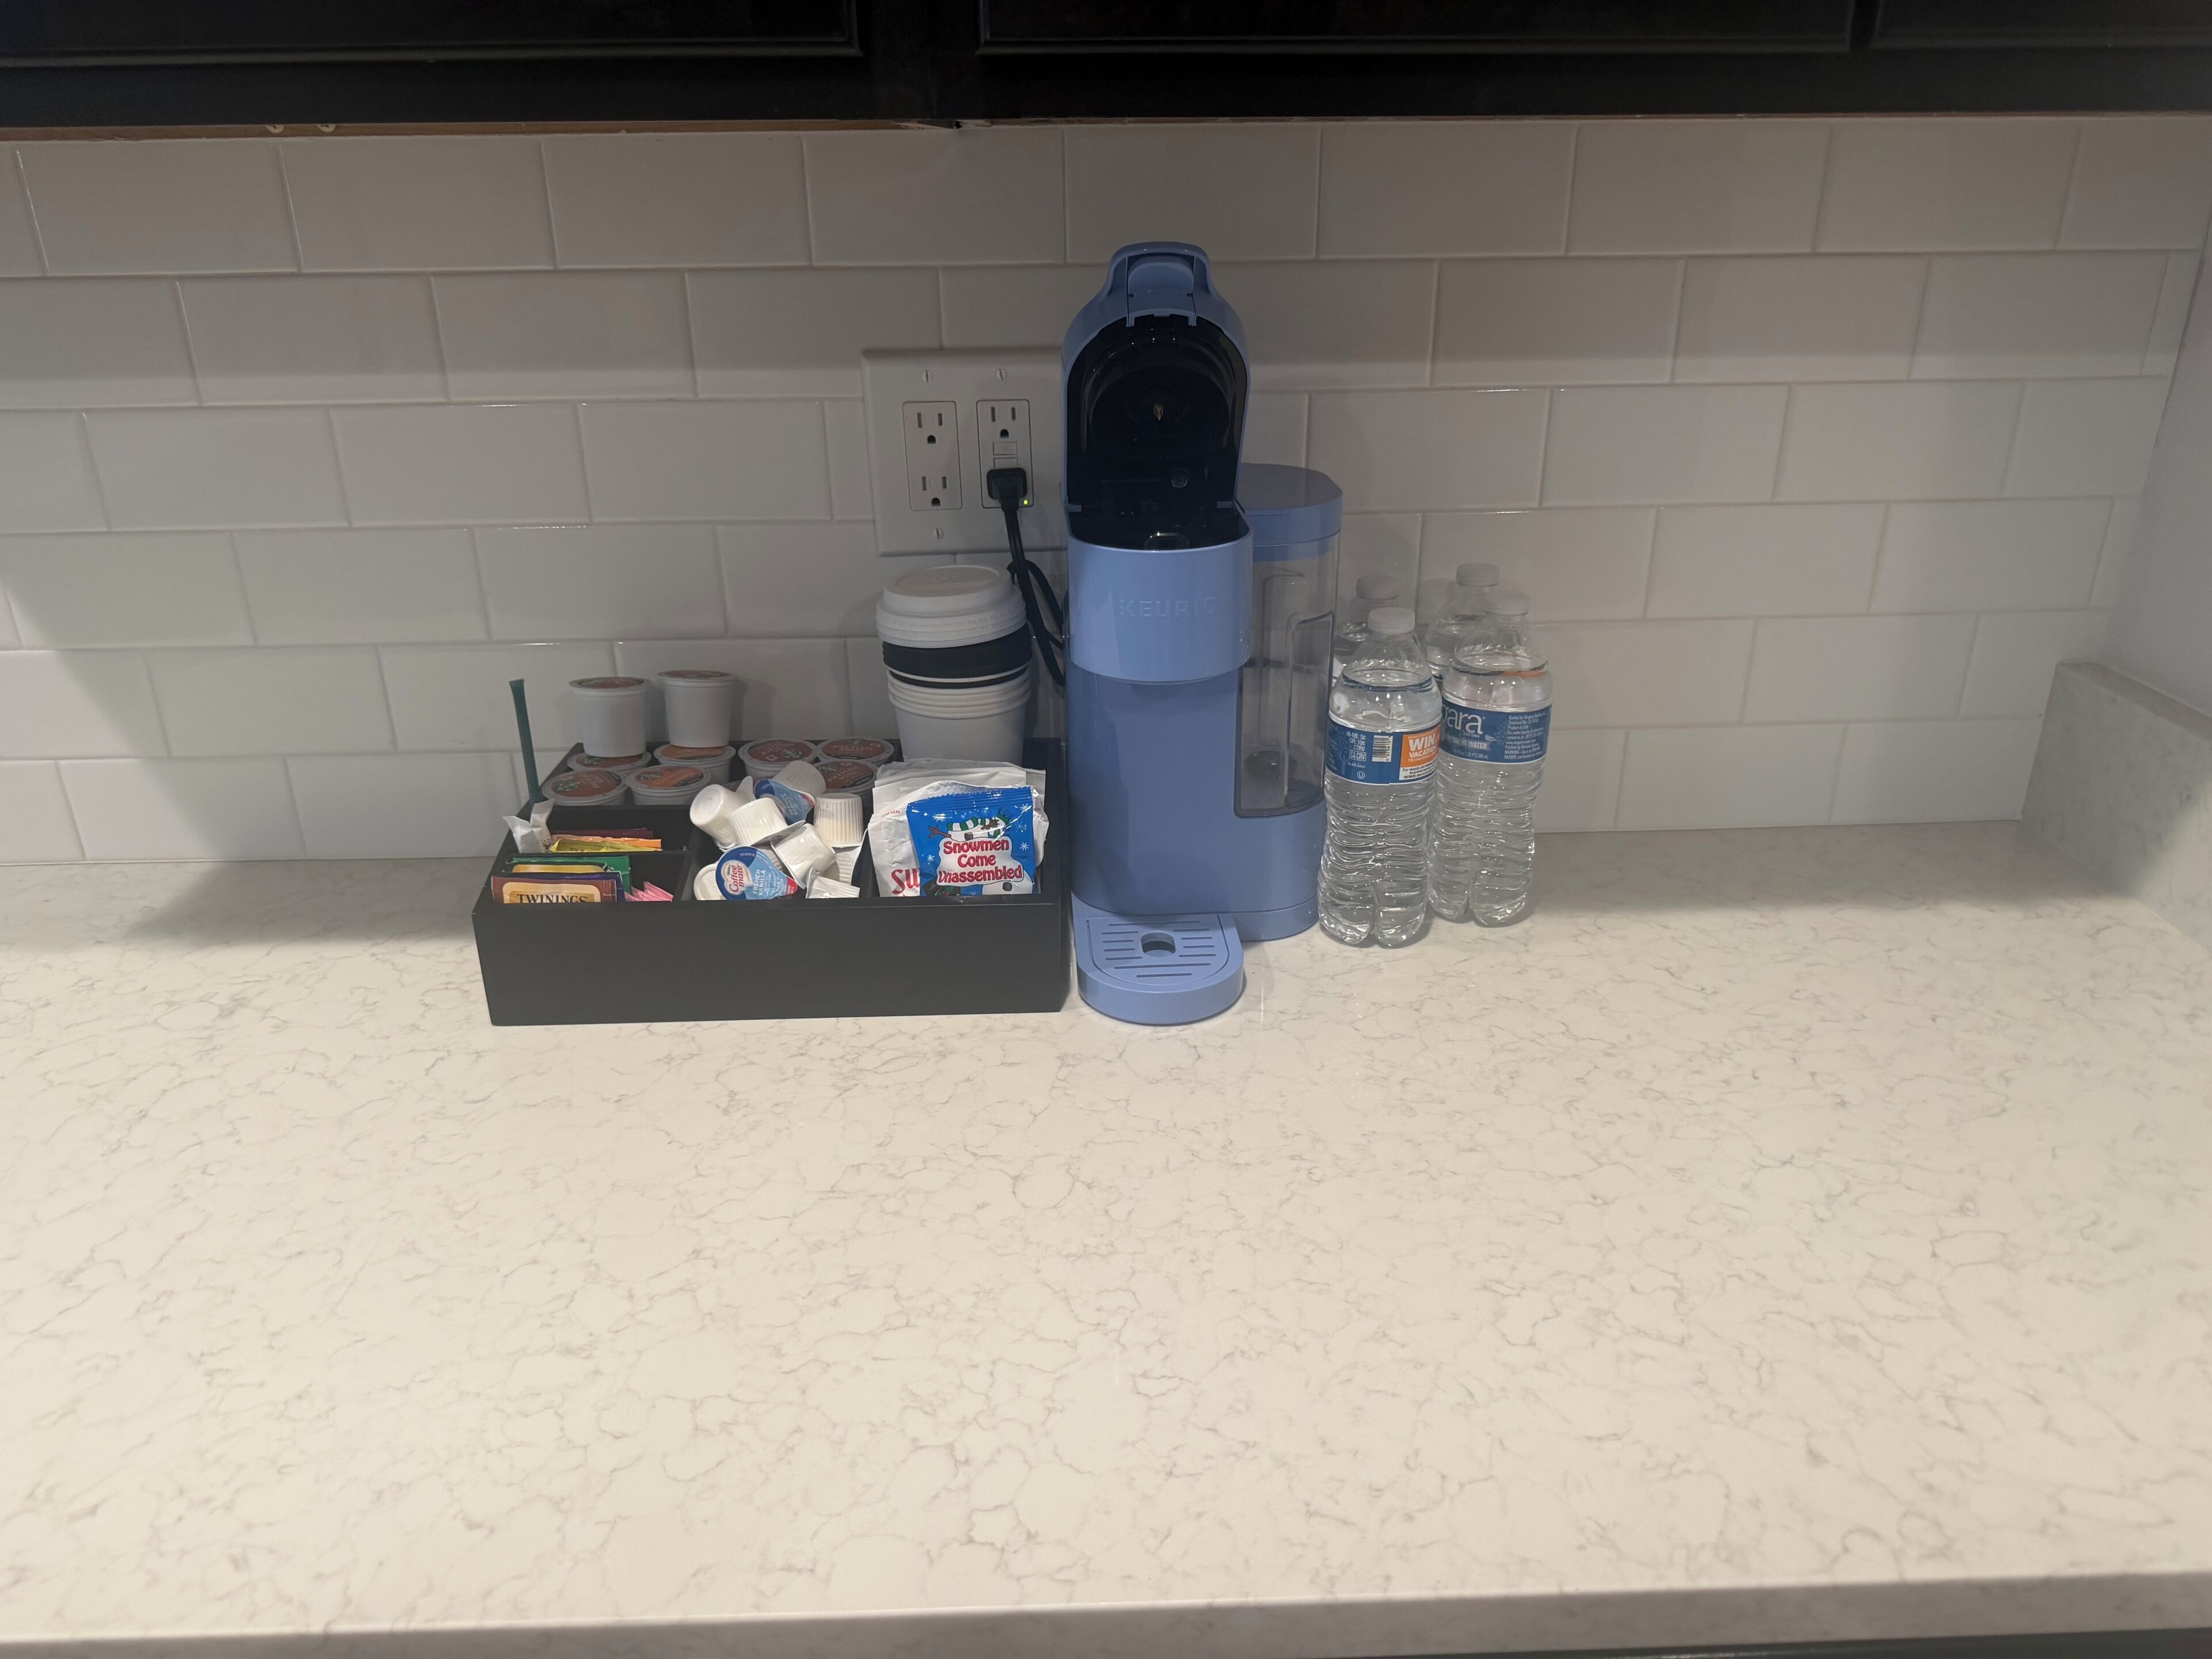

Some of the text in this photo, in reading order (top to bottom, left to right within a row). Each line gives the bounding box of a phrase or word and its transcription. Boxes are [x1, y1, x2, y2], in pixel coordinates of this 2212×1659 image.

[1120, 597, 1217, 618] KEURIG
[1468, 741, 1487, 749] WATER
[943, 838, 1009, 855] Snowmen
[957, 854, 996, 868] Come
[729, 865, 739, 892] Coffee
[737, 865, 745, 888] mate
[753, 869, 762, 895] FRENCH
[757, 869, 766, 896] VANILLA
[938, 864, 1022, 884] Unassembled
[517, 893, 586, 903] TWININGS
